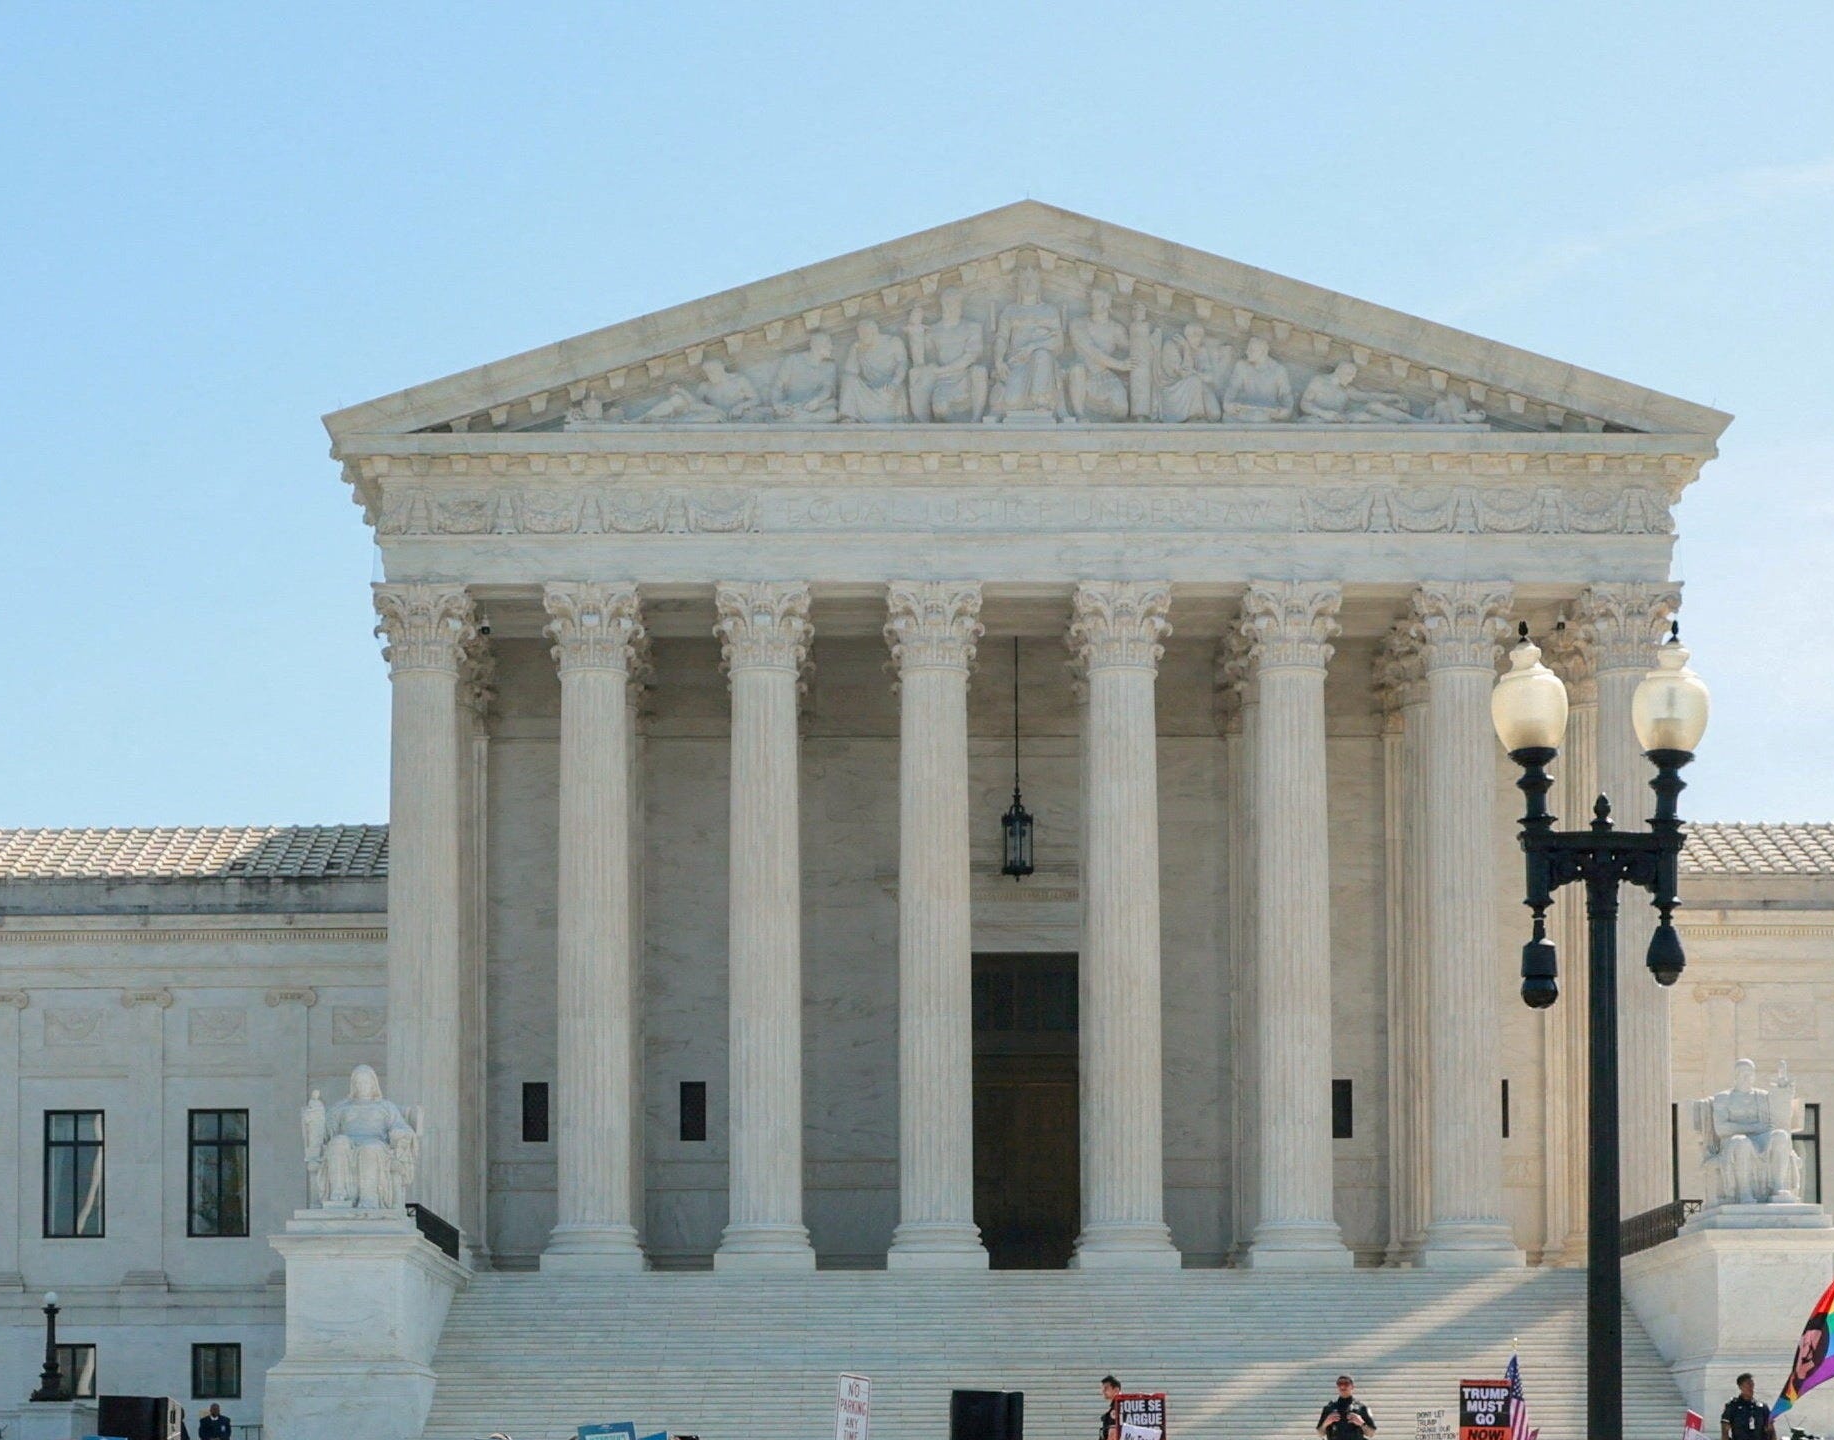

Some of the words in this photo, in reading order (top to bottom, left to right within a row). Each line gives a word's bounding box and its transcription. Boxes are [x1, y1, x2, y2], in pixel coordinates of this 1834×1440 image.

[786, 499, 907, 524] EQUAL
[918, 499, 1058, 524] JUSTICE
[1071, 499, 1189, 524] UNDER
[1205, 499, 1271, 524] LAW
[848, 1383, 860, 1398] NO
[1462, 1388, 1509, 1400] TRUMP
[840, 1398, 867, 1416] PARKING
[1147, 1400, 1163, 1411] SE
[1467, 1400, 1504, 1412] MUST
[845, 1417, 859, 1429] ANY
[1119, 1412, 1163, 1426] LARGUE
[1475, 1413, 1495, 1425] GO
[1467, 1429, 1505, 1440] NOW!
